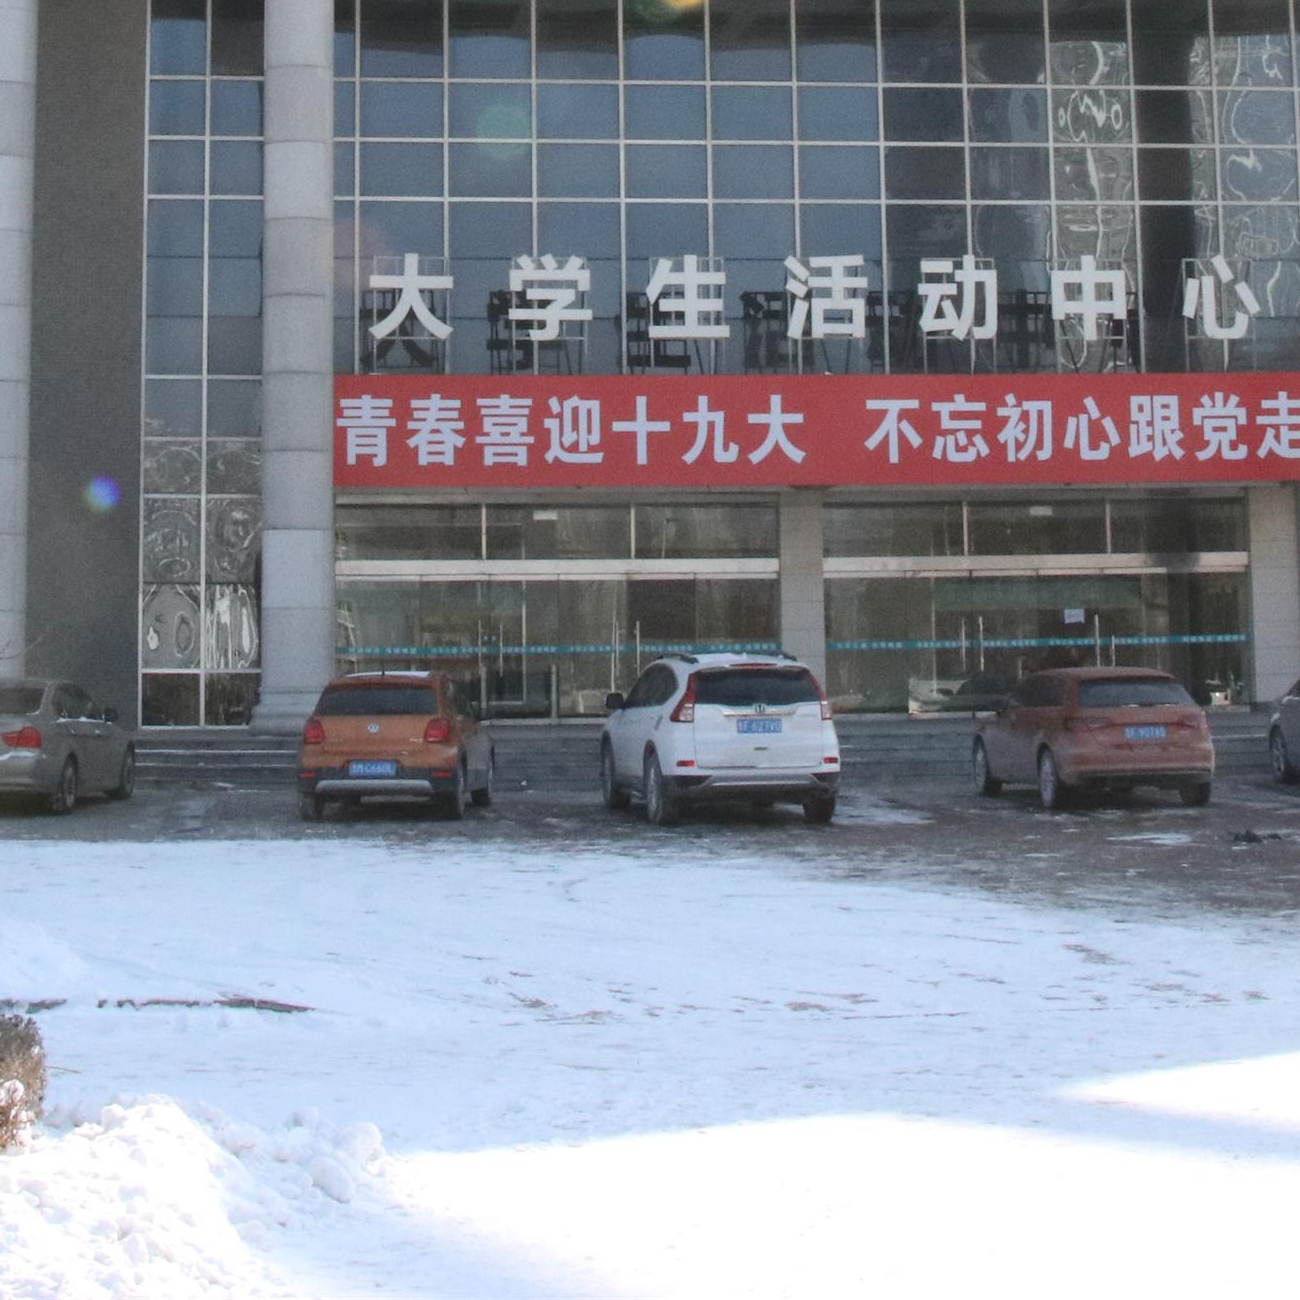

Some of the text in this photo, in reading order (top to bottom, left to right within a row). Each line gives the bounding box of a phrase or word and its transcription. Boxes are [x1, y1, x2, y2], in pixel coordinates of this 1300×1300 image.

[369, 253, 1259, 342] 大学生活动中心
[337, 394, 806, 467] 青春喜迎十九大
